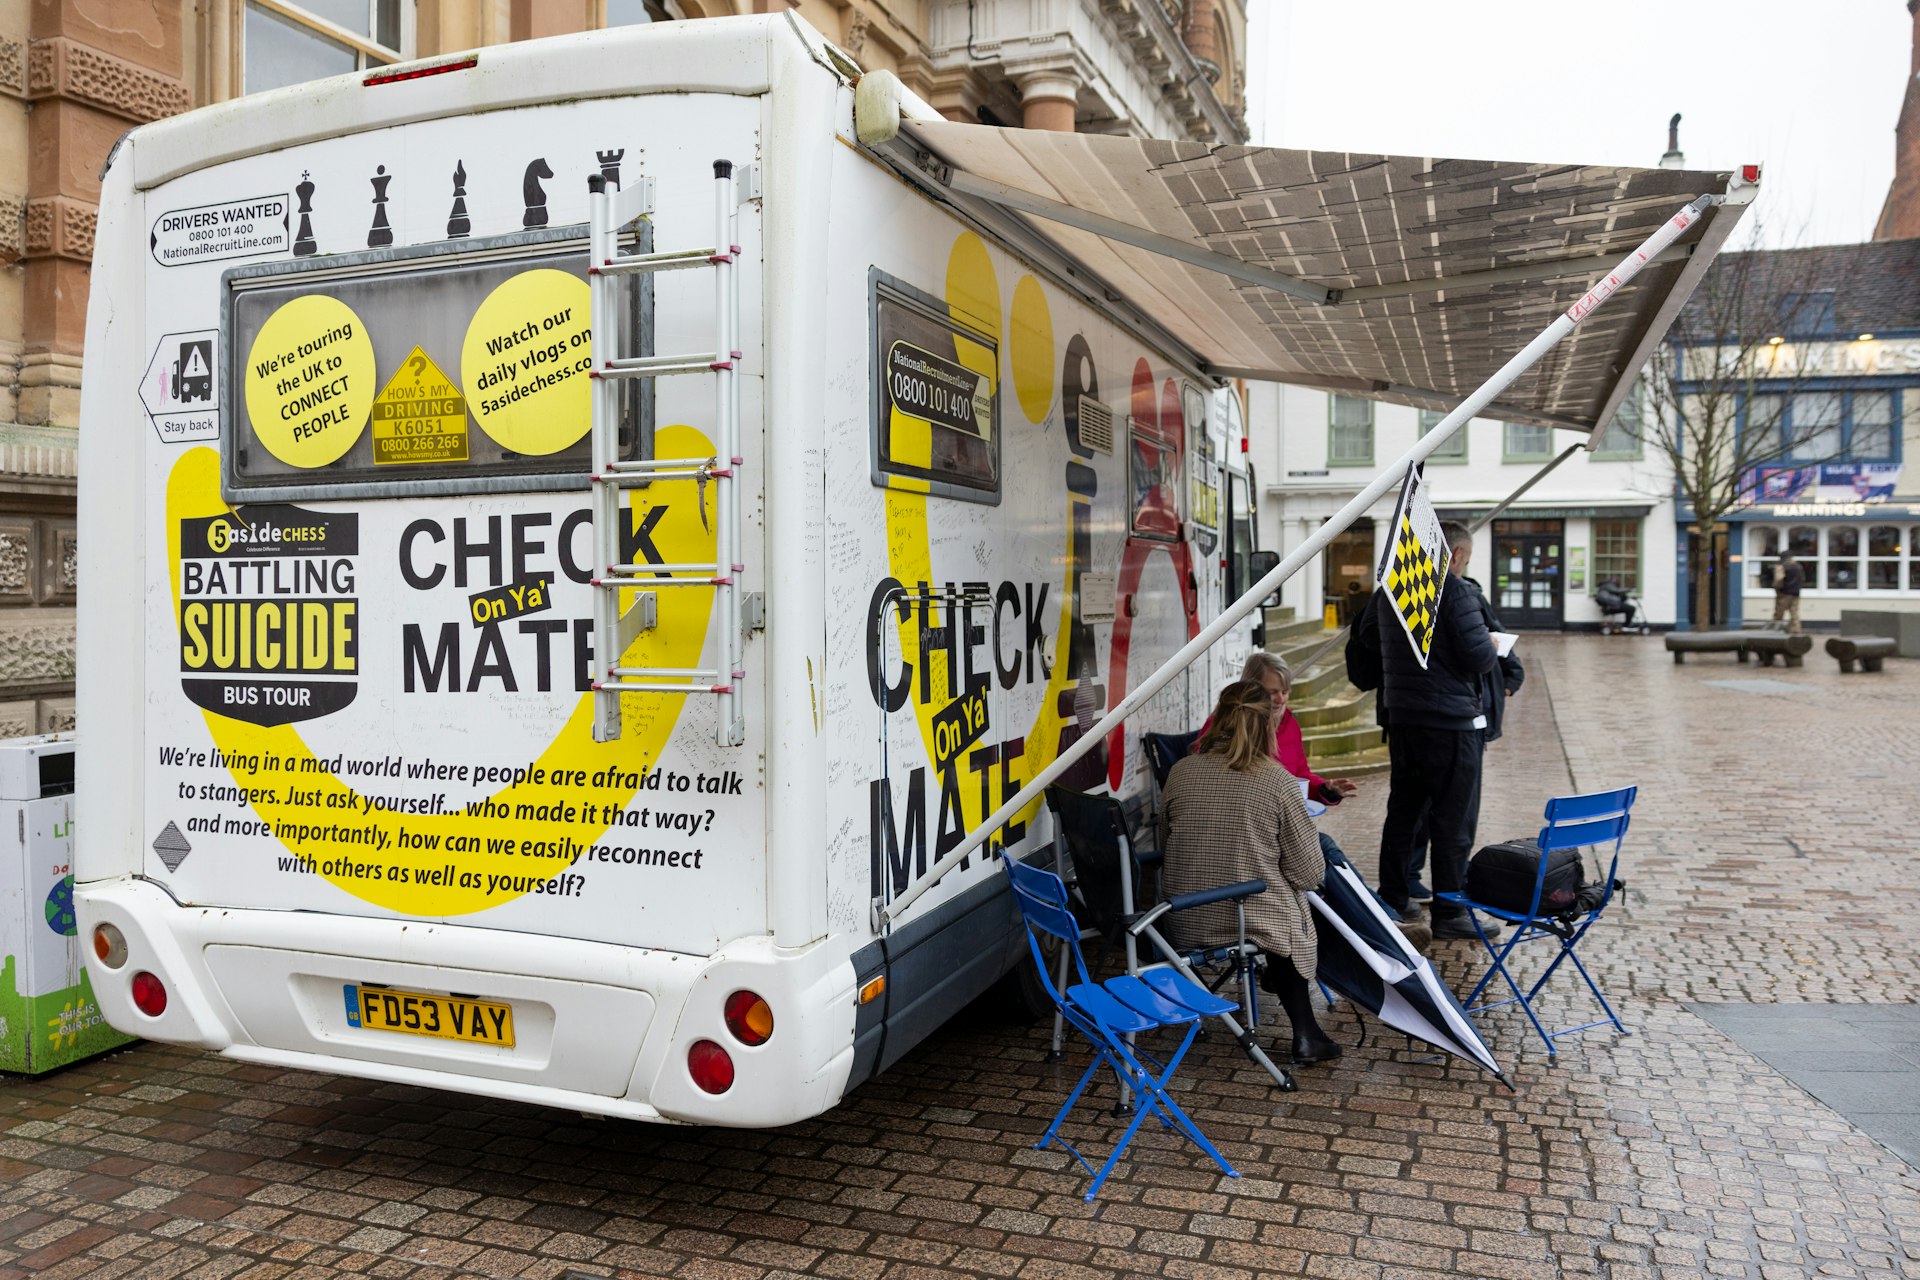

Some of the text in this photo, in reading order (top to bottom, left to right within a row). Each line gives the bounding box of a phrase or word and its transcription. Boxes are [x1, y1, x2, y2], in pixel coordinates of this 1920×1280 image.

[162, 202, 283, 233] DRIVERS WANTED
[188, 223, 254, 242] 0800 101 400
[163, 234, 283, 259] NationalRecruitLine.com
[256, 322, 353, 379] We're touring
[485, 307, 573, 357] Watch our
[276, 355, 342, 396] the UK to
[476, 328, 592, 391] daily vlogs on
[280, 375, 349, 421] CONNECT
[384, 400, 454, 419] DRIVING
[387, 384, 449, 401] HOW'S MY
[894, 372, 970, 421] 0800 101 400
[164, 418, 214, 435] Stay back
[292, 404, 350, 443] PEOPLE
[393, 420, 444, 437] K6051
[381, 435, 459, 453] 0800 266 266
[391, 449, 451, 461] www.howsmy.co.uk
[1773, 503, 1866, 517] MANNINGS
[399, 504, 674, 591] CHECK
[184, 558, 355, 595] BATTLING
[472, 579, 546, 624] On Ya'
[183, 602, 356, 671] SUICIDE
[866, 576, 1052, 713] CHECK
[223, 686, 311, 706] BUS TOUR
[935, 719, 962, 762] On
[961, 685, 988, 738] Ya'
[159, 746, 744, 796] We're living in a mad world where people are afraid to talk
[54, 820, 75, 838] LI
[178, 782, 716, 837] to stangers. Just ask yourself... who made it that way?
[870, 736, 1026, 911] MATE
[187, 814, 704, 870] and more importantly, how can we easily reconnect
[278, 853, 586, 897] with others as well as yourself?
[59, 1003, 95, 1022] THIS IS
[59, 1020, 83, 1036] OUR
[349, 1011, 359, 1021] GB
[363, 992, 506, 1041] FD53 VAY
